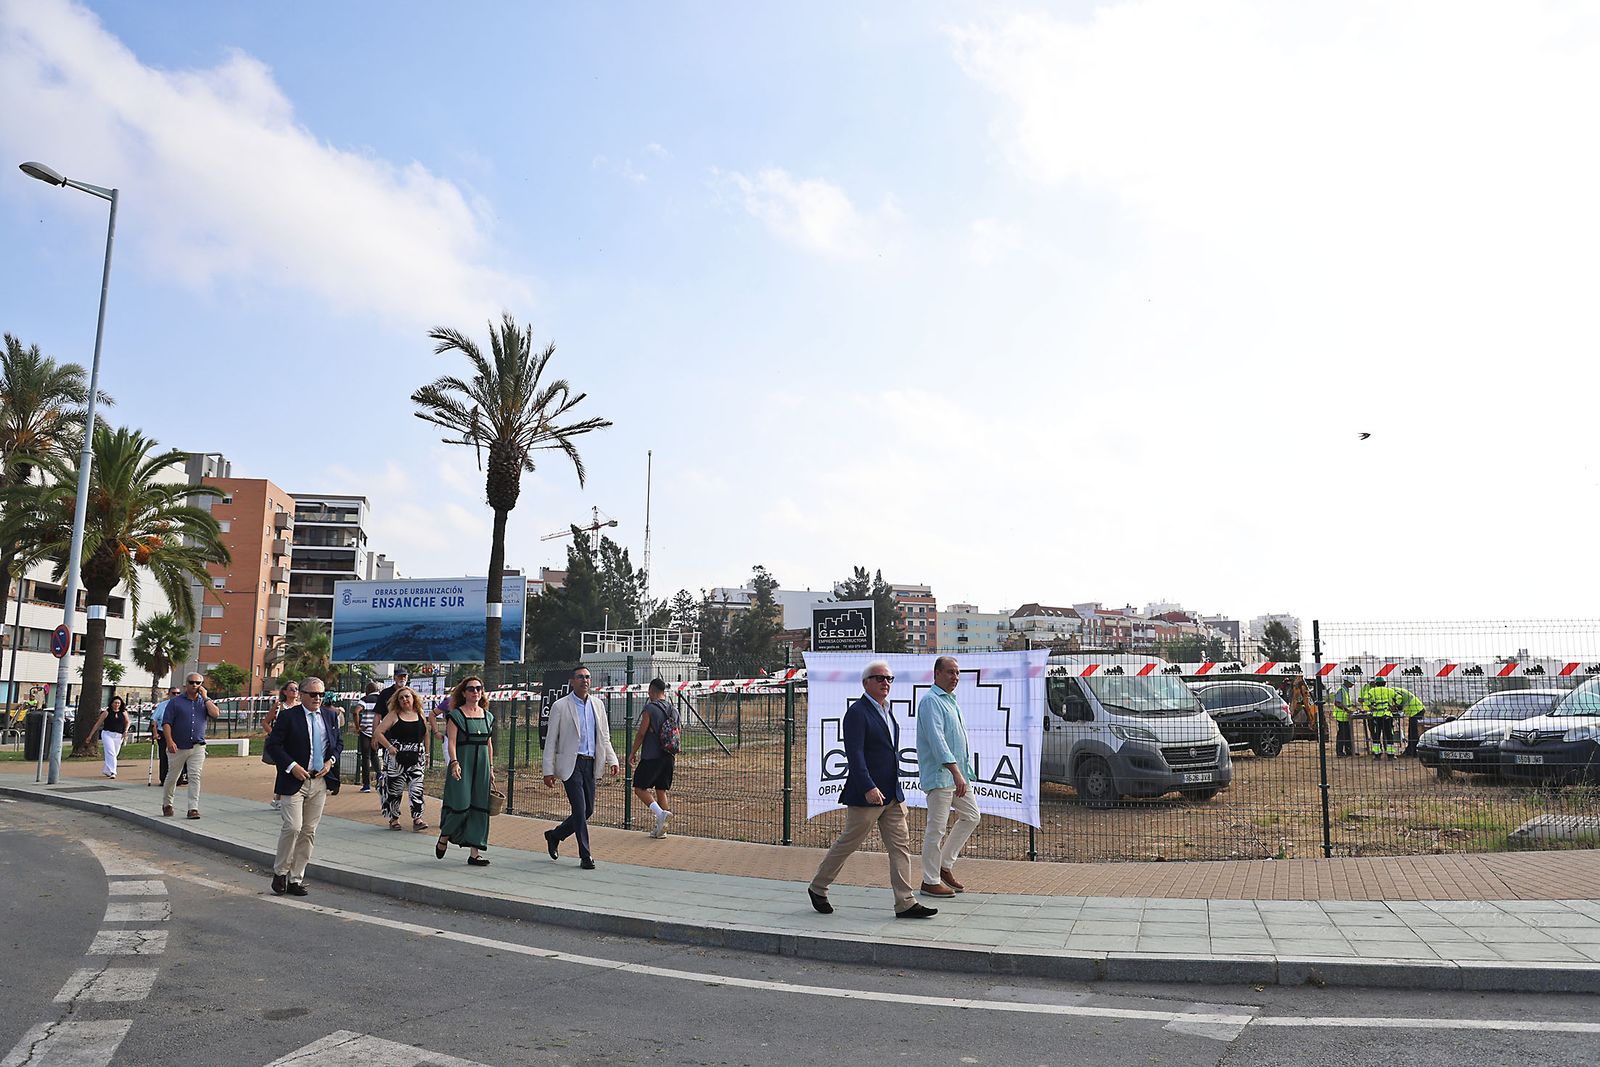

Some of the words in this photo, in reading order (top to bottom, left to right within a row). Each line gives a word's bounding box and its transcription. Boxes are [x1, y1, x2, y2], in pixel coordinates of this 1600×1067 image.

[375, 588, 398, 596] OBRAS
[410, 585, 463, 595] URBANIZACIÓN
[372, 596, 436, 608] ENSANCHE
[440, 596, 465, 607] SUR
[819, 629, 866, 638] GESTIA
[823, 748, 1021, 789] GSIA
[818, 783, 843, 796] OBRA
[971, 785, 1022, 804] NSANCHE
